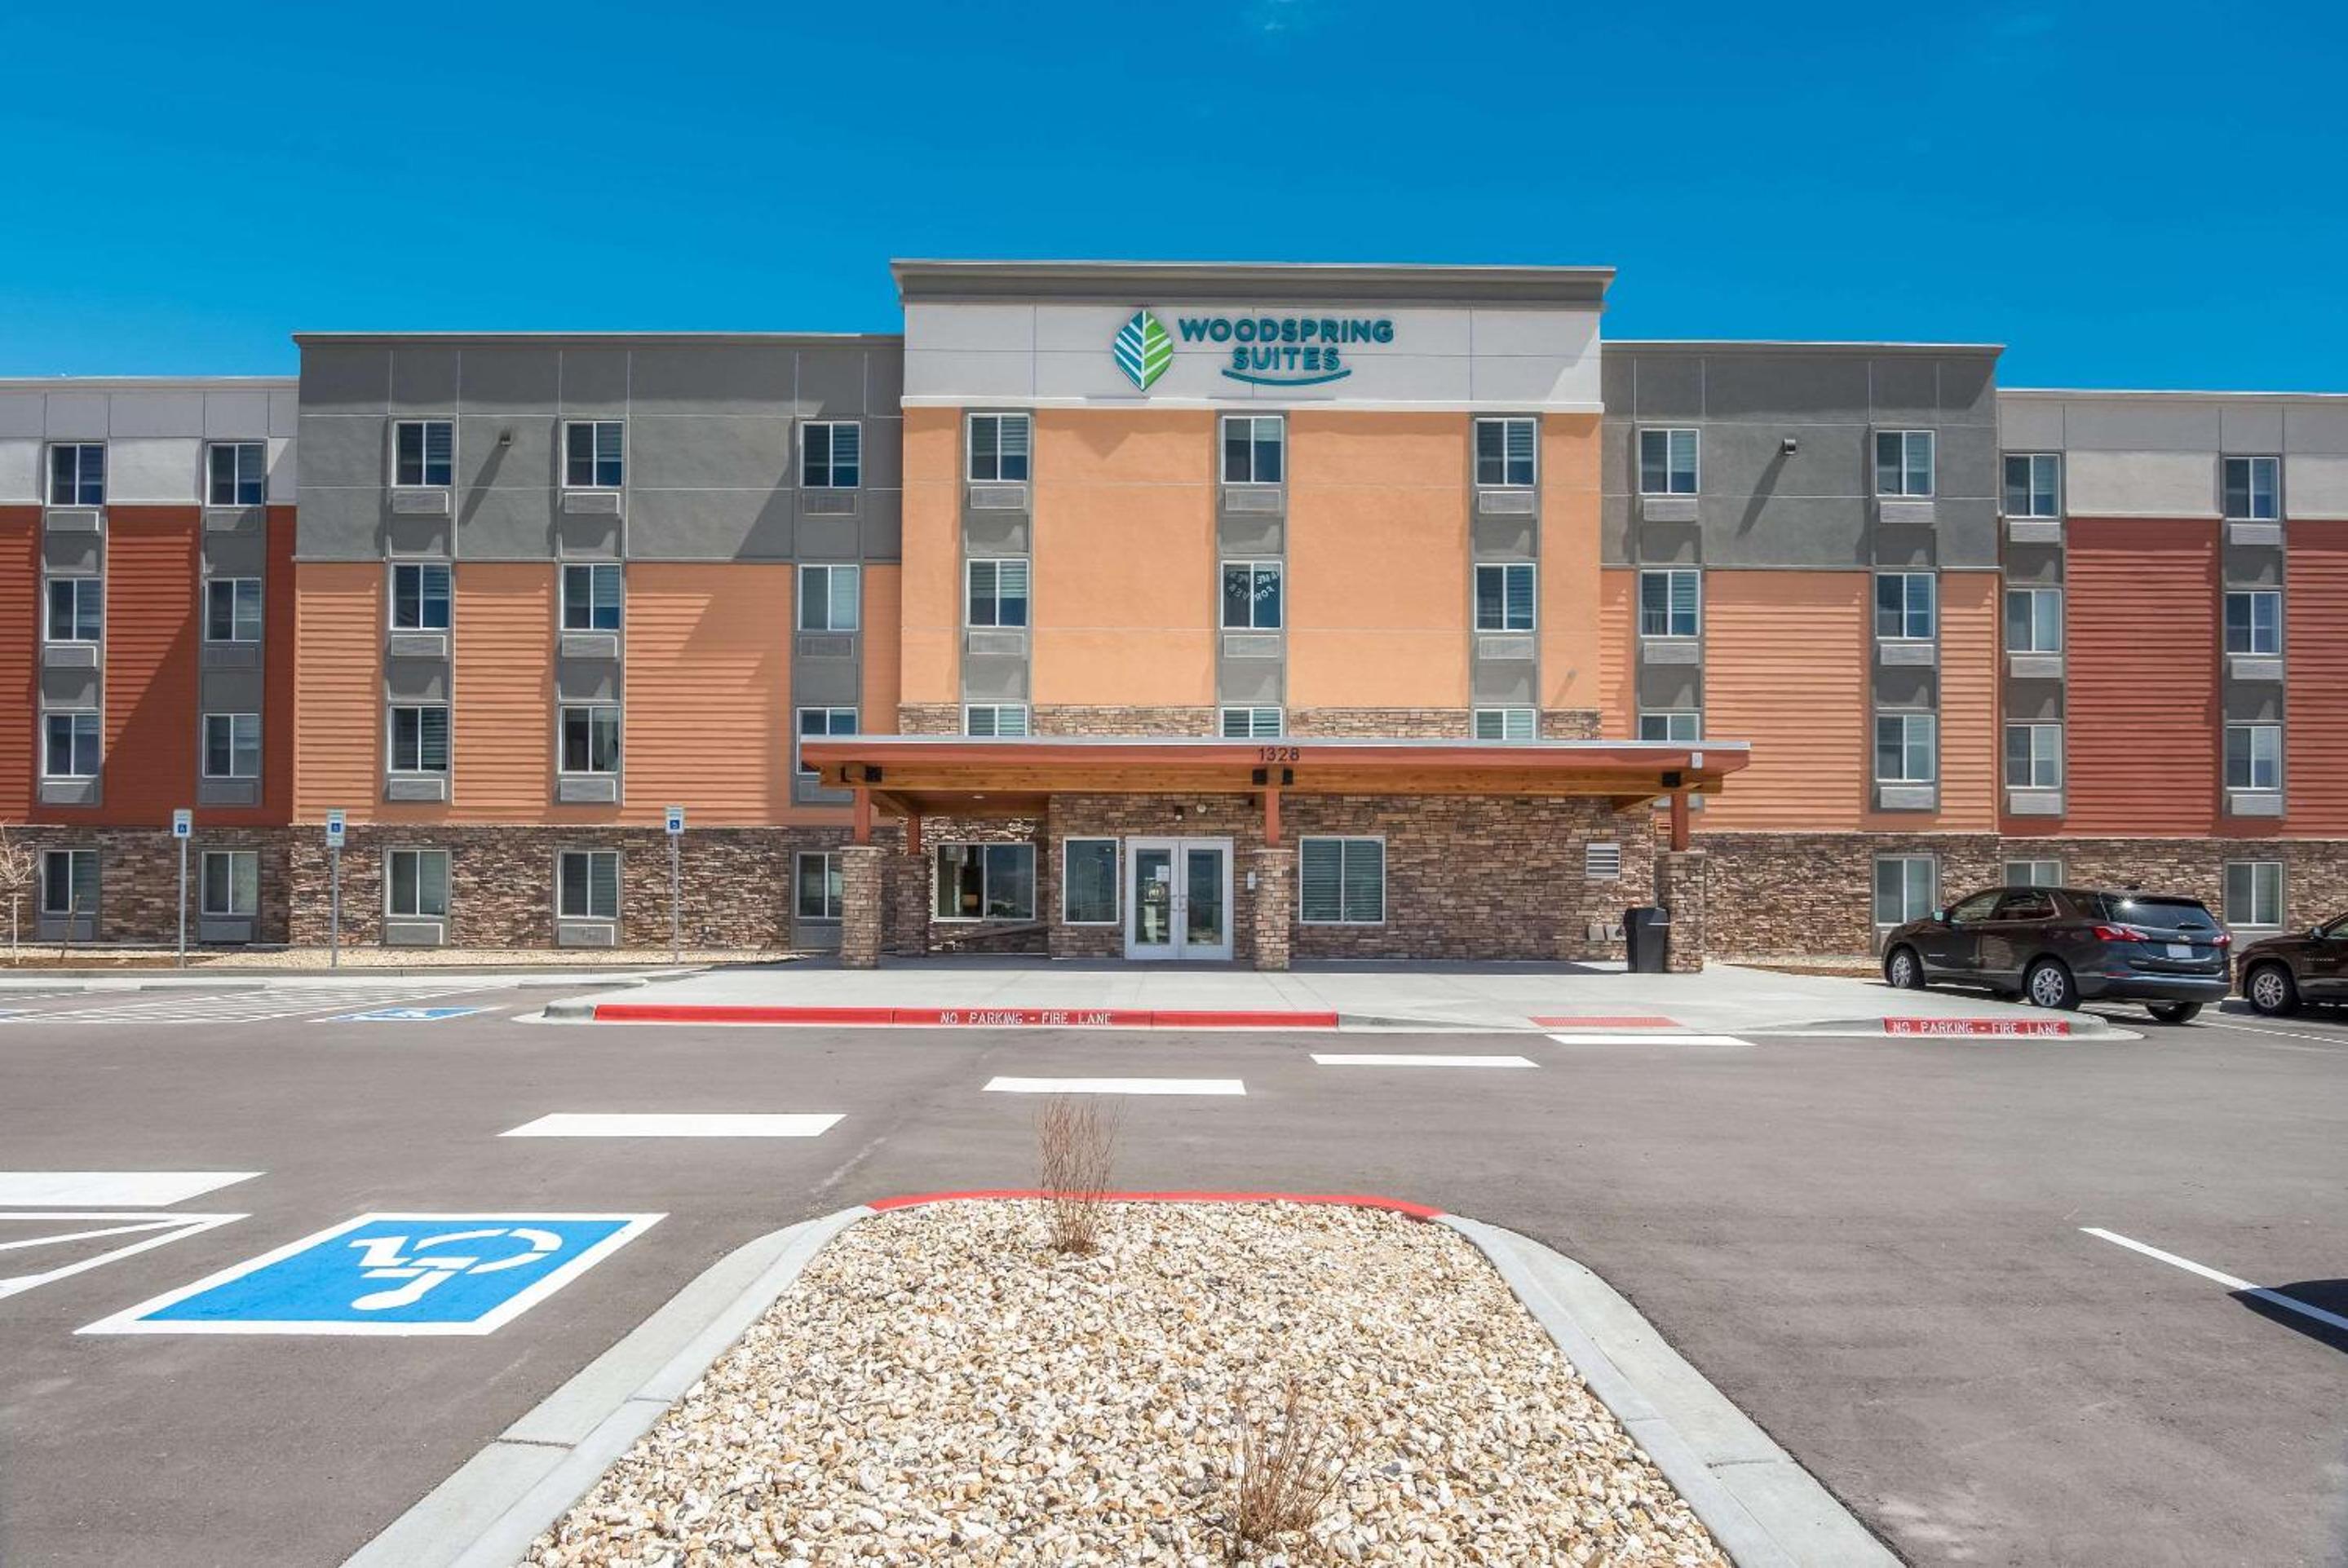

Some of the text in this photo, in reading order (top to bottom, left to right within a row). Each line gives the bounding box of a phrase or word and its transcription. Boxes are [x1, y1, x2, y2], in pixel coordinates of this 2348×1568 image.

[1178, 318, 1395, 343] WOODSPRING
[1231, 347, 1341, 371] SUITES
[1258, 747, 1300, 762] 1328
[940, 1012, 958, 1025] NO
[969, 1012, 1023, 1025] PARKING
[1041, 1012, 1068, 1025] FIRE
[1077, 1013, 1112, 1025] LANE
[1893, 1021, 1911, 1032] NO
[1921, 1021, 1974, 1034] PARKING
[1992, 1022, 2018, 1035] FIRE
[2027, 1023, 2060, 1036] LANE
